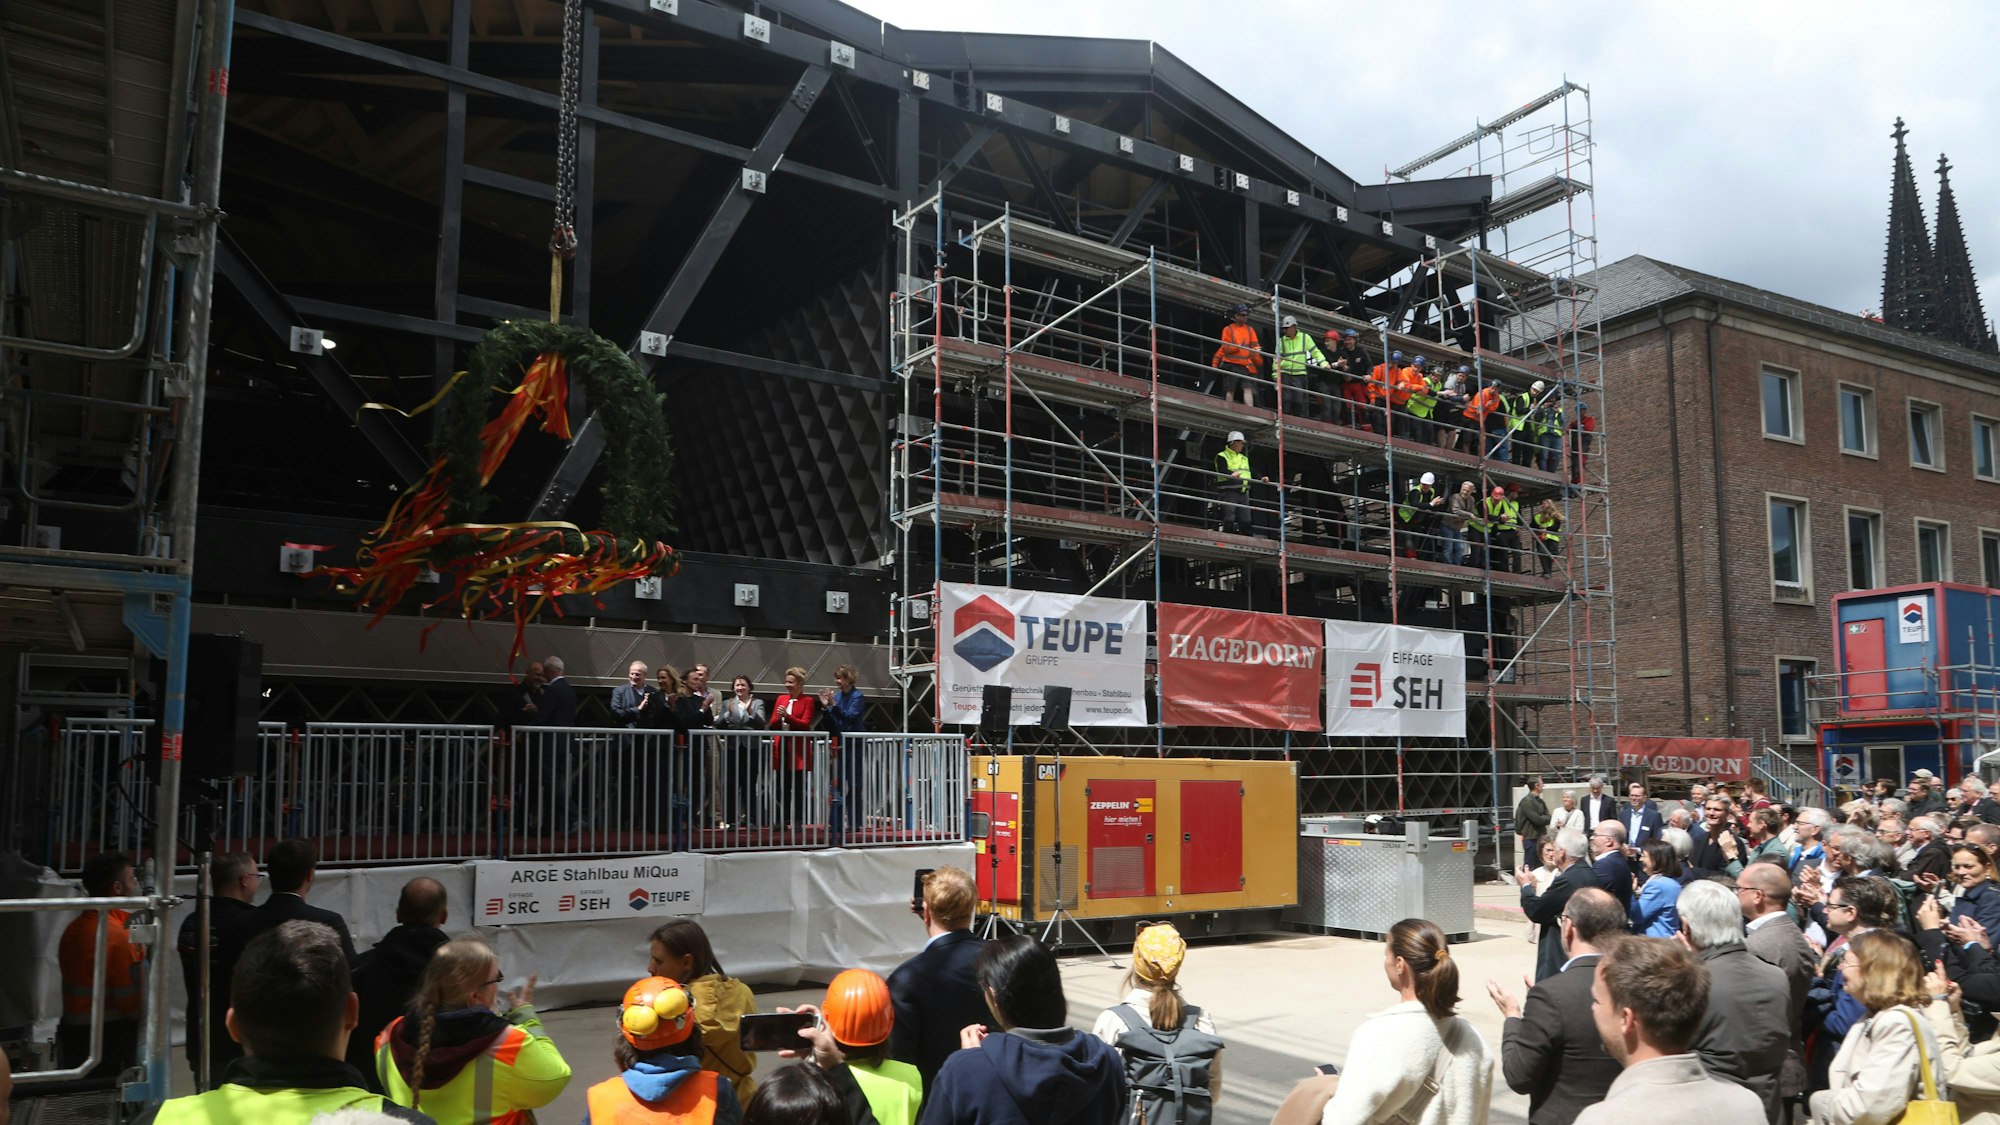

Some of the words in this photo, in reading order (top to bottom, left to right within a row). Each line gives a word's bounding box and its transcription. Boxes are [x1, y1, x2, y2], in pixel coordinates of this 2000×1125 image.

[1020, 615, 1123, 655] TEUPE
[1902, 625, 1926, 633] TEUPE
[1168, 633, 1317, 670] HAGEDORN
[1025, 654, 1059, 666] GRUPPE
[1393, 651, 1433, 667] EIFFAGE
[1102, 689, 1132, 698] Stahlbau
[1393, 675, 1443, 710] SEH
[1085, 706, 1133, 715] www.teupe.de
[1622, 753, 1743, 775] HAGEDORN
[1090, 801, 1130, 810] ZEPPELIN
[1104, 815, 1118, 823] hier
[510, 869, 558, 884] ARGE
[562, 866, 629, 882] Stahlbau
[633, 865, 679, 879] MiQua
[651, 890, 691, 903] TEUPE
[507, 900, 540, 915] SRC
[579, 897, 610, 911] SEH
